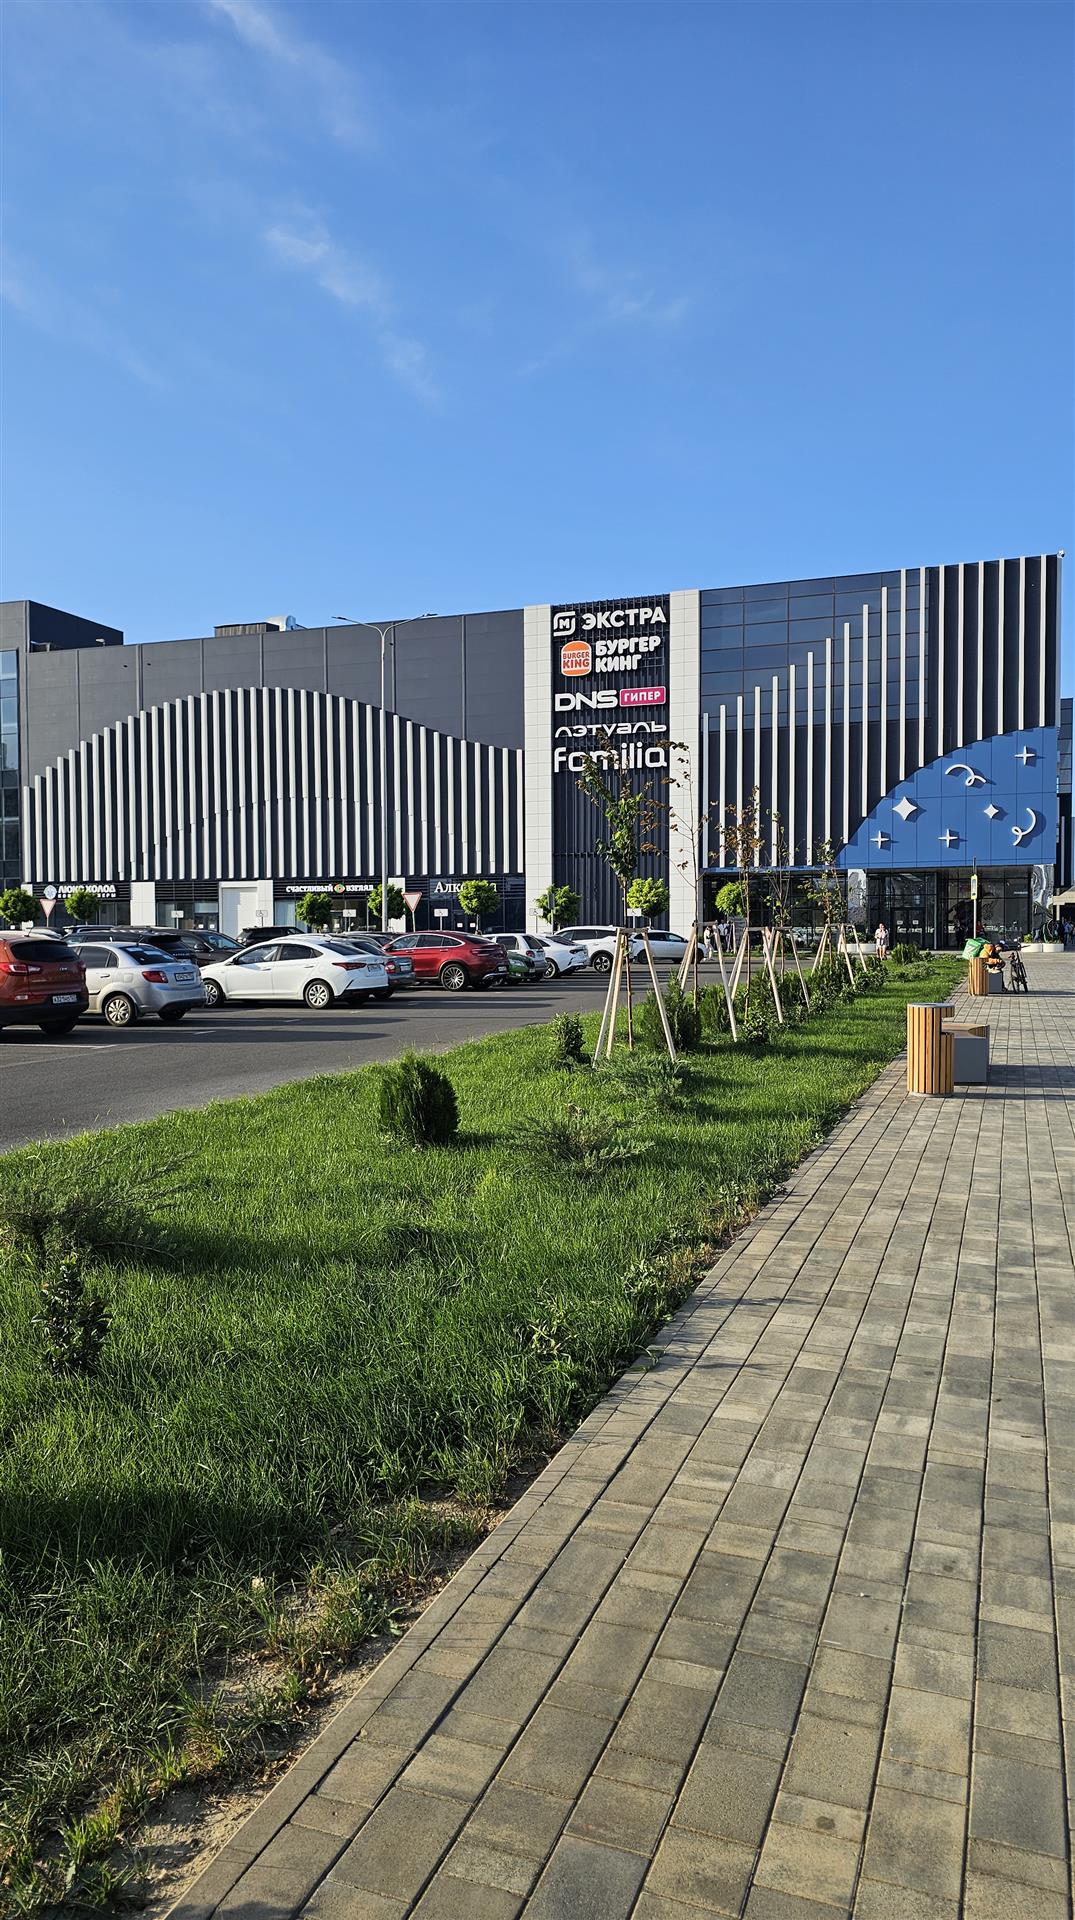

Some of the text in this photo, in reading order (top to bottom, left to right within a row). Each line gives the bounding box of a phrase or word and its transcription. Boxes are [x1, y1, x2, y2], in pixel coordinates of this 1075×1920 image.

[582, 607, 666, 630] ЭКСТРА
[562, 651, 590, 659] BURGER
[595, 635, 661, 656] БУРГЕР
[562, 658, 590, 669] KING
[595, 654, 642, 673] КИНГ
[555, 690, 618, 711] DNS
[624, 691, 661, 703] ГИПЕР
